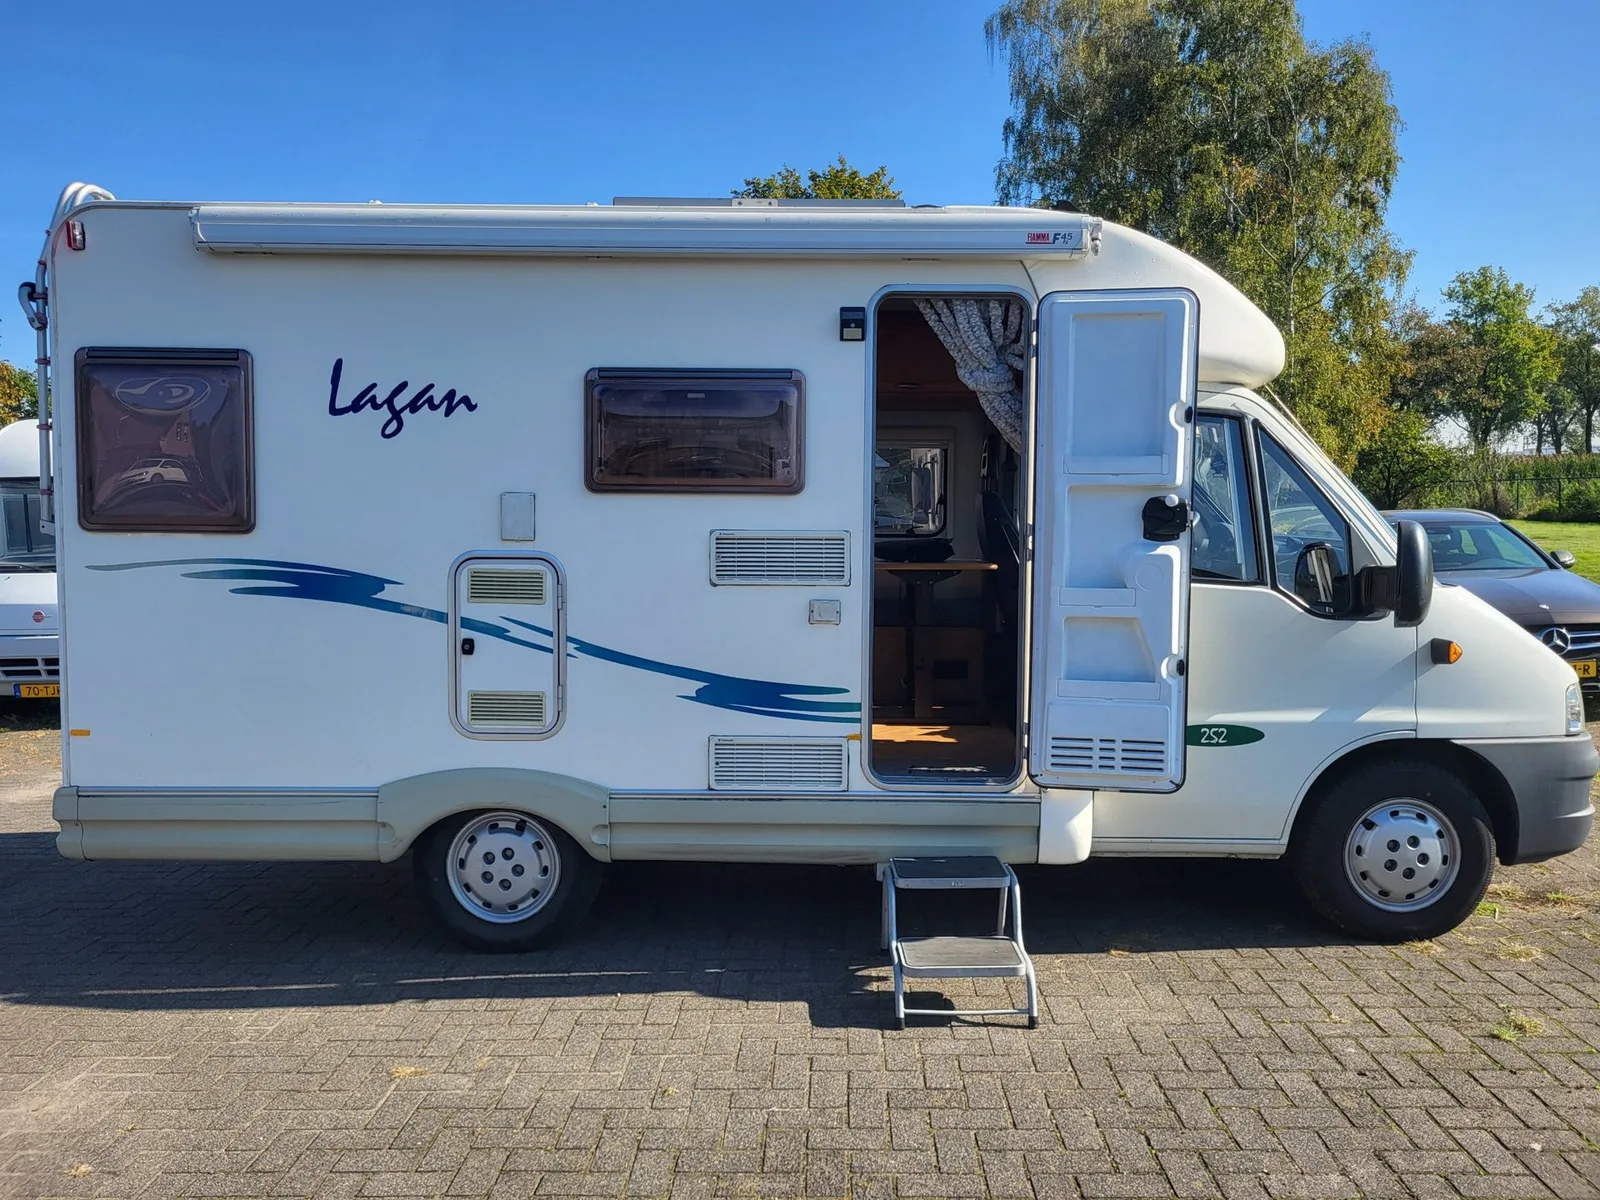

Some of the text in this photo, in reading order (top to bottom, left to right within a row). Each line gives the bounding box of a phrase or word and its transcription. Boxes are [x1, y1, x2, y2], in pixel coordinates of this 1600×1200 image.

[1027, 232, 1050, 242] FIAMMA
[329, 358, 478, 439] Lagan
[1200, 727, 1228, 744] 252
